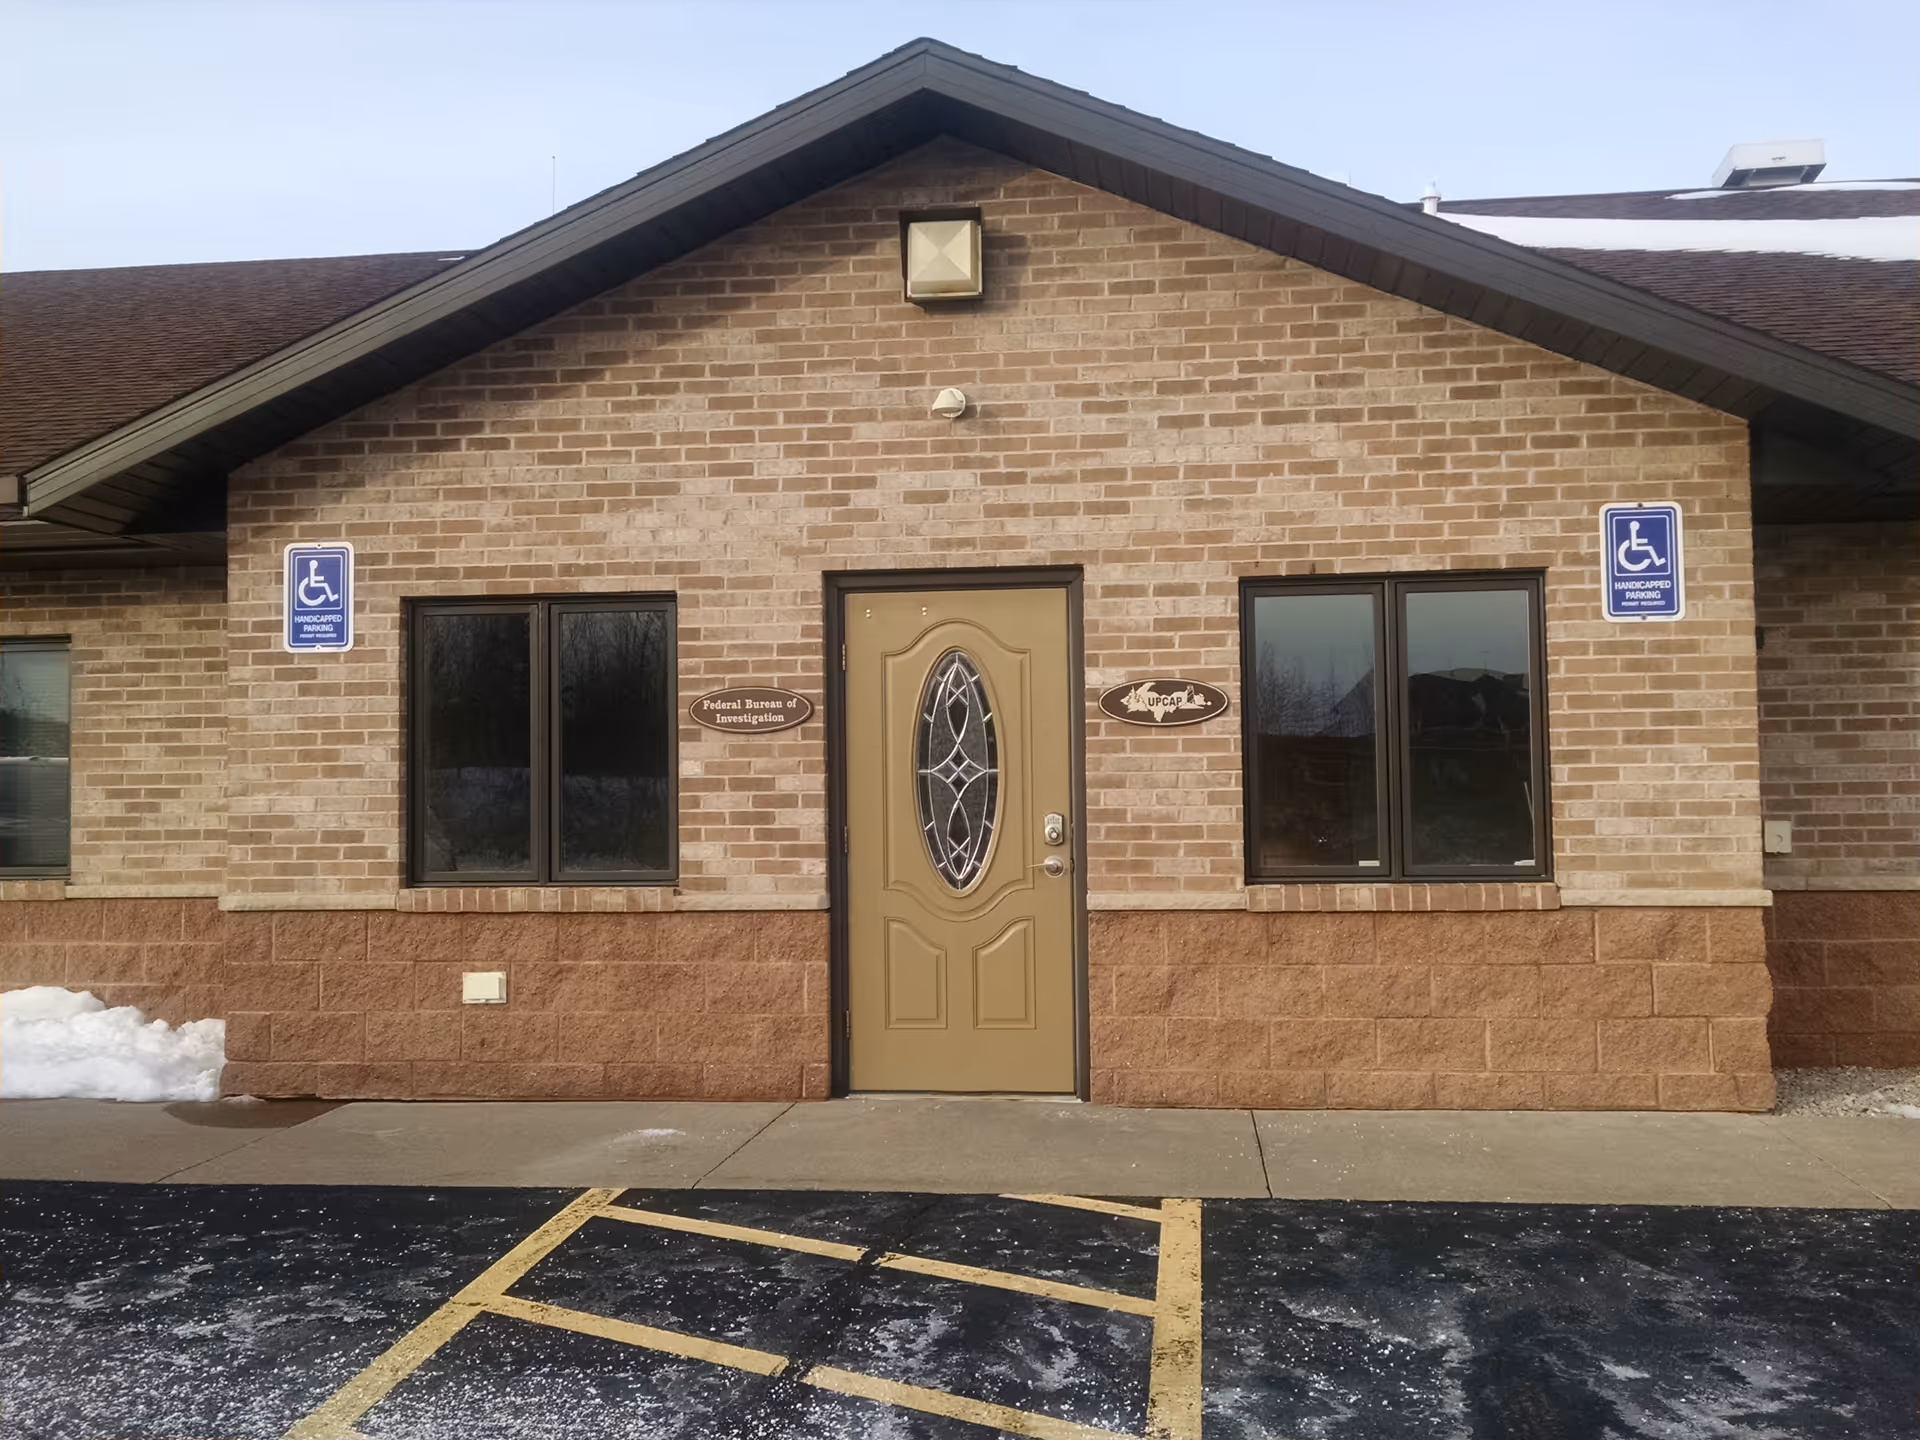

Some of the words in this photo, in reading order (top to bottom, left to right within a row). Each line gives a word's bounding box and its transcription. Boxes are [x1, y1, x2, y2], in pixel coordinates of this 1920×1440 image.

[1614, 580, 1672, 590] HANDICAPPED
[1625, 590, 1662, 600] PARKING
[294, 614, 343, 623] HANDICAPPED
[303, 623, 334, 632] PARKING
[703, 700, 741, 710] Federal
[745, 699, 783, 709] Bureau
[786, 697, 798, 708] of
[1147, 697, 1183, 707] UPCAP
[715, 712, 785, 725] Investigation
